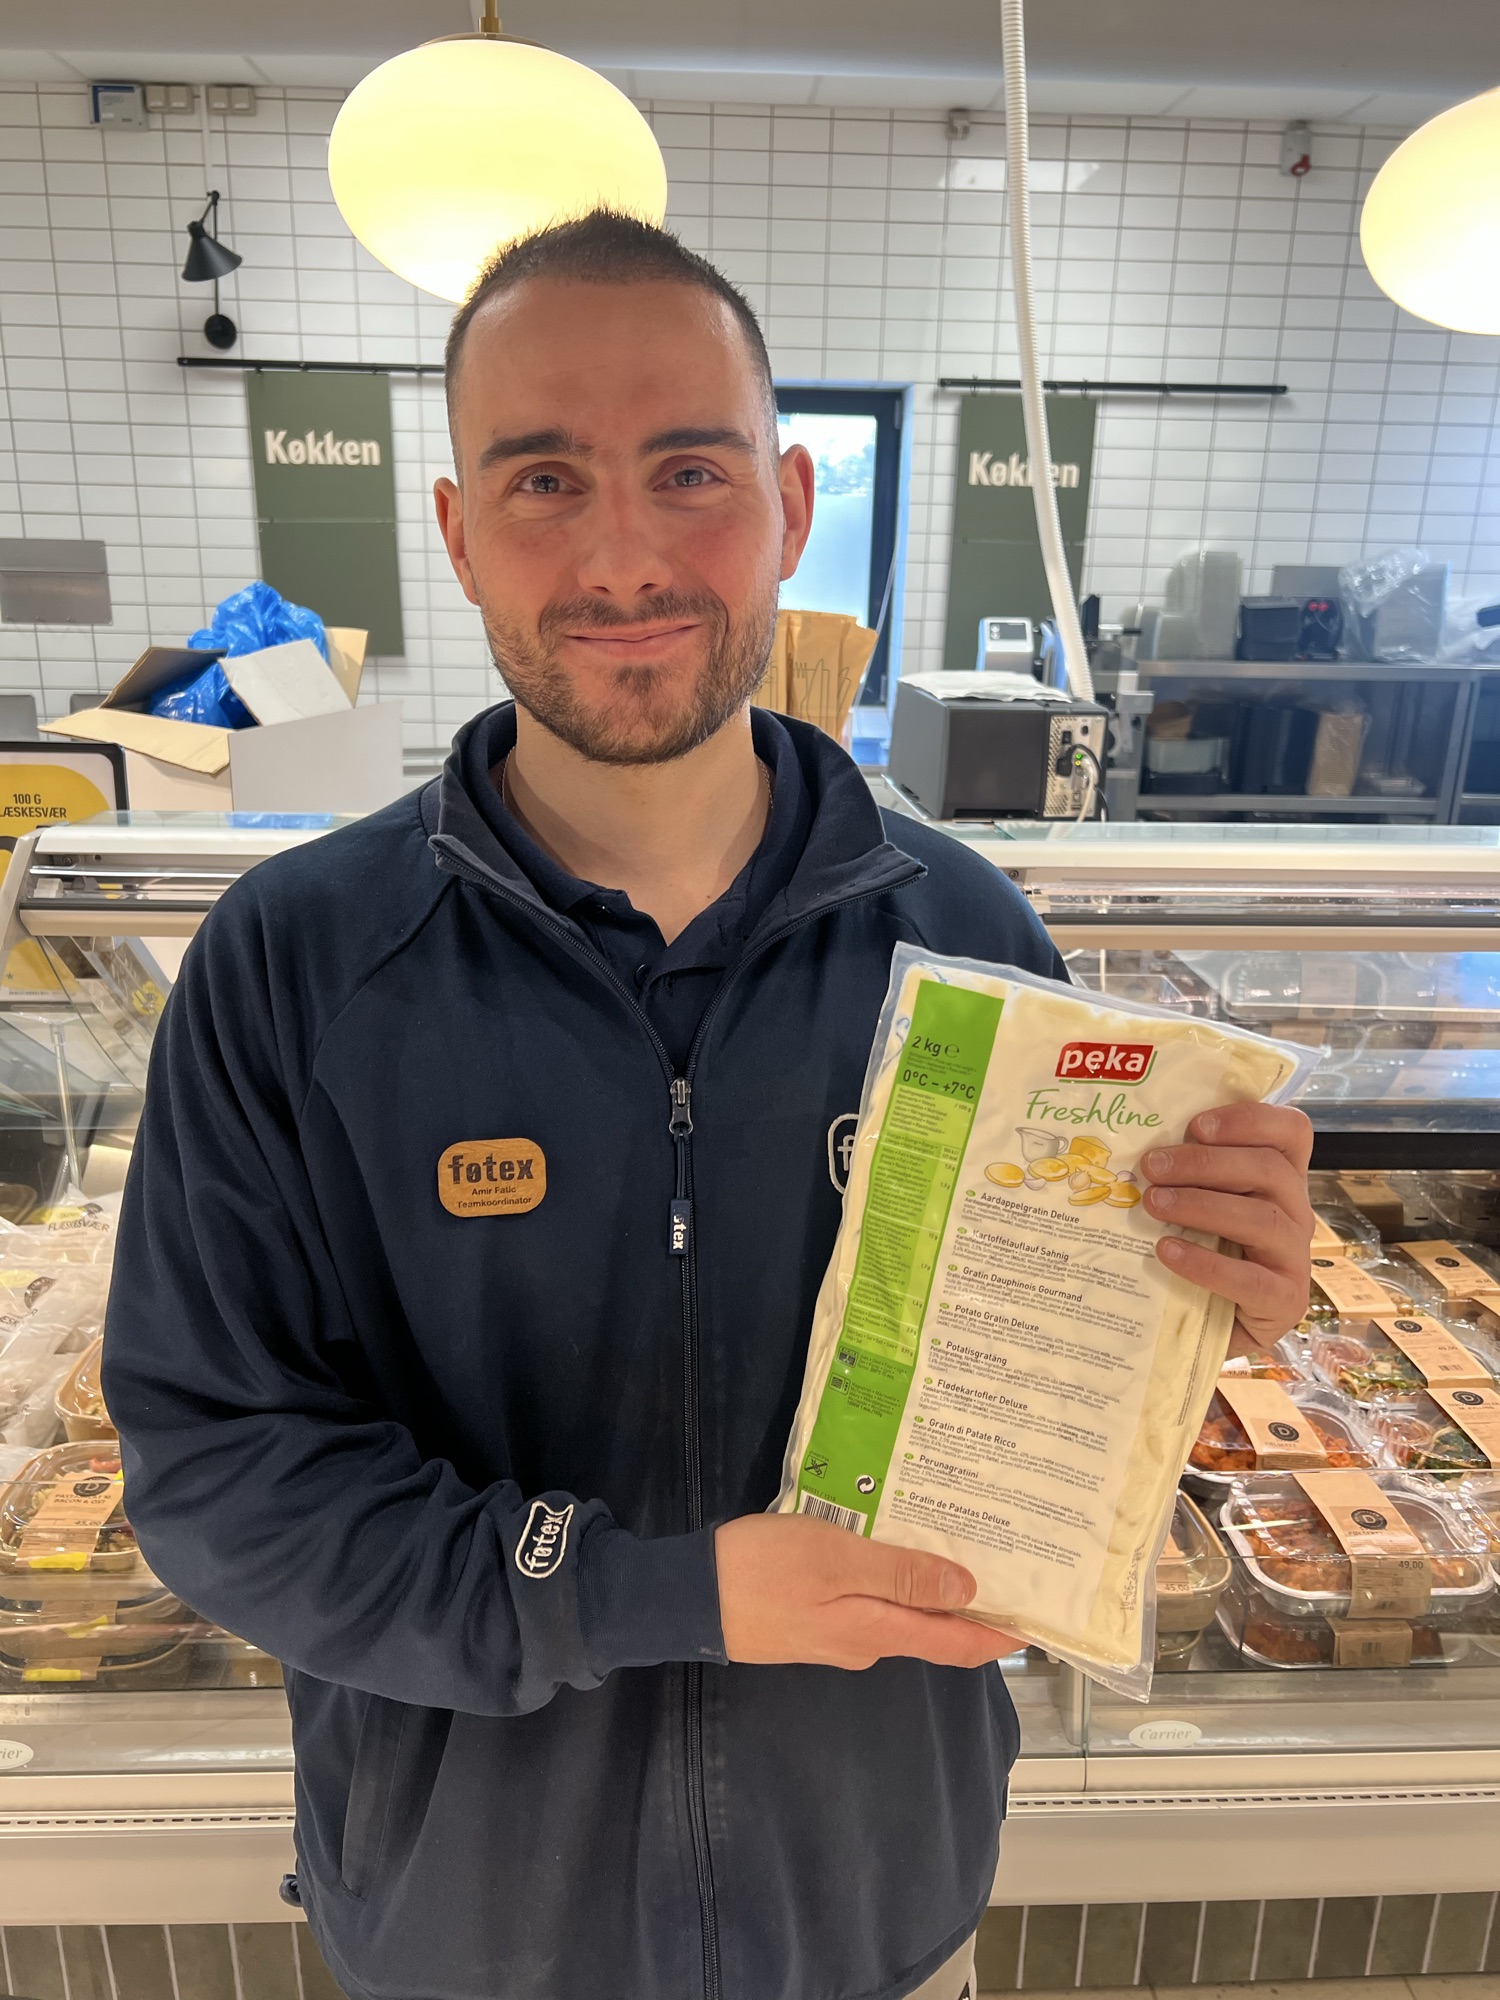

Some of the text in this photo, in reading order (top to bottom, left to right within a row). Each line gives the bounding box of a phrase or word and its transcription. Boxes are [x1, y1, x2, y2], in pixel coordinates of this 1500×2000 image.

[264, 429, 381, 466] Køkken
[0, 806, 67, 818] ÆSKESVÆR
[13, 794, 42, 805] 100 G
[912, 1035, 942, 1057] 2 kg
[1060, 1045, 1145, 1075] peka
[903, 1069, 929, 1087] 0°C
[943, 1081, 976, 1099] +7°C
[1026, 1089, 1164, 1134] Freshline
[447, 1153, 535, 1185] føtex
[457, 1197, 533, 1209] Teamkoordinator
[472, 1186, 493, 1196] Amir
[980, 1192, 1080, 1224] Aardappelgratin Deluxe
[972, 1228, 1070, 1262] Kartoffelauflauf Sahnig
[963, 1266, 1083, 1302] Gratin Dauphinois Gourmand
[954, 1305, 1040, 1332] Potato Gratin Deluxe
[946, 1341, 1007, 1366] Potatisgratäng
[937, 1379, 1028, 1411] Flødekartofler Deluxe
[929, 1418, 1017, 1449] Gratin di Patate Ricco
[919, 1454, 979, 1479] Perunagratiini
[909, 1491, 1011, 1527] Gratin de Patatas Deluxe
[524, 1514, 563, 1571] føtex
[1139, 1728, 1192, 1741] Carrier
